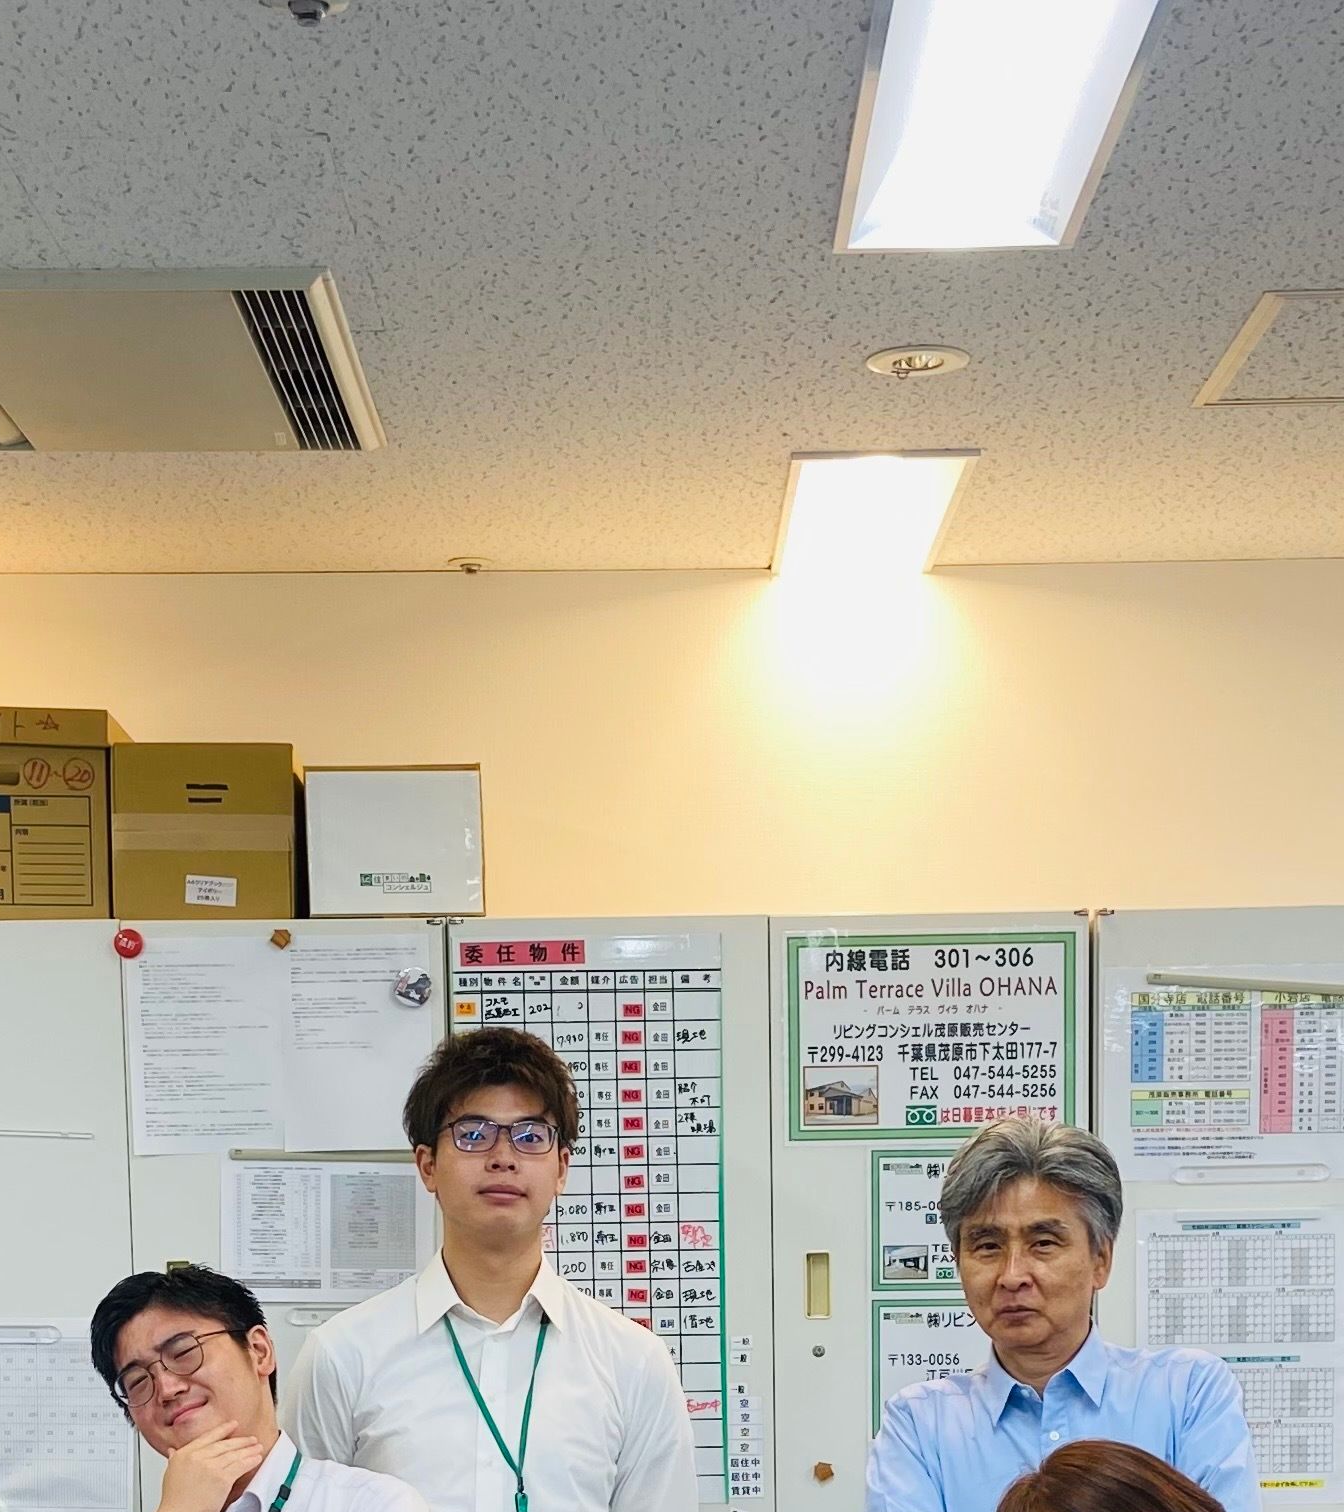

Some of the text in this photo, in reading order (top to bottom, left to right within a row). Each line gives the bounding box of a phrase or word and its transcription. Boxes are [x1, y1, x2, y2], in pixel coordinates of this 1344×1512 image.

[465, 943, 581, 963] 委任物件
[825, 949, 910, 972] 内線電話
[459, 978, 478, 987] 種別
[484, 976, 522, 986] 物件名
[560, 975, 579, 986] 金額
[591, 974, 610, 984] 媒介
[620, 975, 639, 984] 広告
[648, 974, 668, 984] 担当
[681, 974, 711, 983] 備考
[805, 976, 1058, 1000] Palm Terrace Villa OHANA
[528, 1003, 552, 1015] 202
[625, 1006, 640, 1014] NG
[908, 1005, 930, 1014] テラス
[937, 1004, 958, 1014] ヴィラ
[966, 1004, 989, 1013] オハナ
[833, 1023, 1031, 1040] リビングコンシェル茂原販売センター
[595, 1032, 609, 1042] 専任
[624, 1032, 640, 1042] NG
[808, 1042, 1058, 1063] 〒299-4123 千葉県茂原市下太田177-7
[594, 1062, 609, 1071] 専任
[624, 1062, 638, 1071] NG
[909, 1066, 1056, 1081] TEL 047-544-5255
[597, 1091, 612, 1100] 専任
[624, 1090, 639, 1100] NG
[910, 1083, 1056, 1100] FAX 047-544-5256
[596, 1118, 611, 1128] 専任
[626, 1118, 641, 1128] NG
[627, 1147, 641, 1156] NG
[627, 1177, 642, 1186] NG
[627, 1206, 642, 1214] NG
[630, 1236, 644, 1245] NG
[562, 1261, 586, 1274] 200
[600, 1262, 614, 1271] 専任
[629, 1261, 643, 1271] NG
[631, 1291, 644, 1300] NG
[733, 1354, 747, 1362] 一般
[888, 1354, 960, 1366] 〒133-0056
[731, 1385, 745, 1393] 一般
[740, 1399, 749, 1408] 空
[741, 1413, 750, 1422] 空
[741, 1428, 750, 1437] 空
[740, 1443, 749, 1452] 空
[730, 1458, 760, 1468] 居住中
[731, 1472, 761, 1481] 居住中
[731, 1486, 761, 1495] 賃貸中
